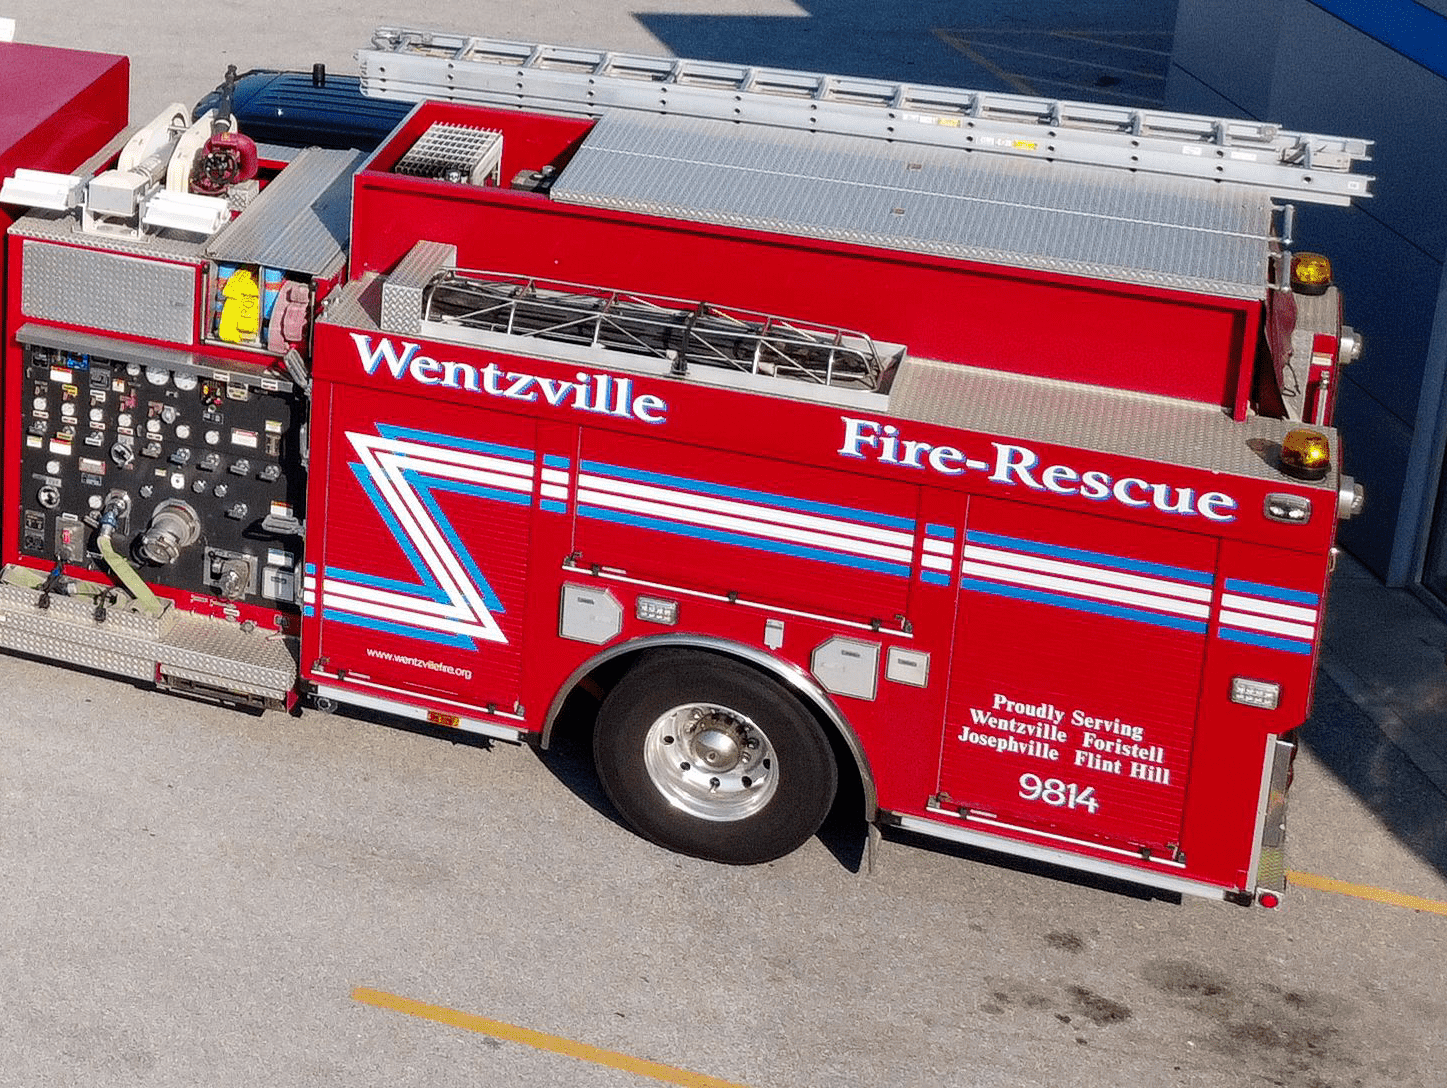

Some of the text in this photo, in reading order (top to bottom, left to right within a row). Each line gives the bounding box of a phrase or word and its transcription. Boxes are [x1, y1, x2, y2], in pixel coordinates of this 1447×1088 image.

[349, 332, 668, 425] Wentzville
[837, 416, 1239, 523] Fire-Rescue
[366, 648, 473, 680] www.wentzvillefire.org
[969, 708, 1165, 764] Wentzville Foristell
[993, 693, 1144, 742] Proudly Serving
[958, 726, 1171, 785] Josephville Flint Hill
[1018, 773, 1100, 814] 9814
